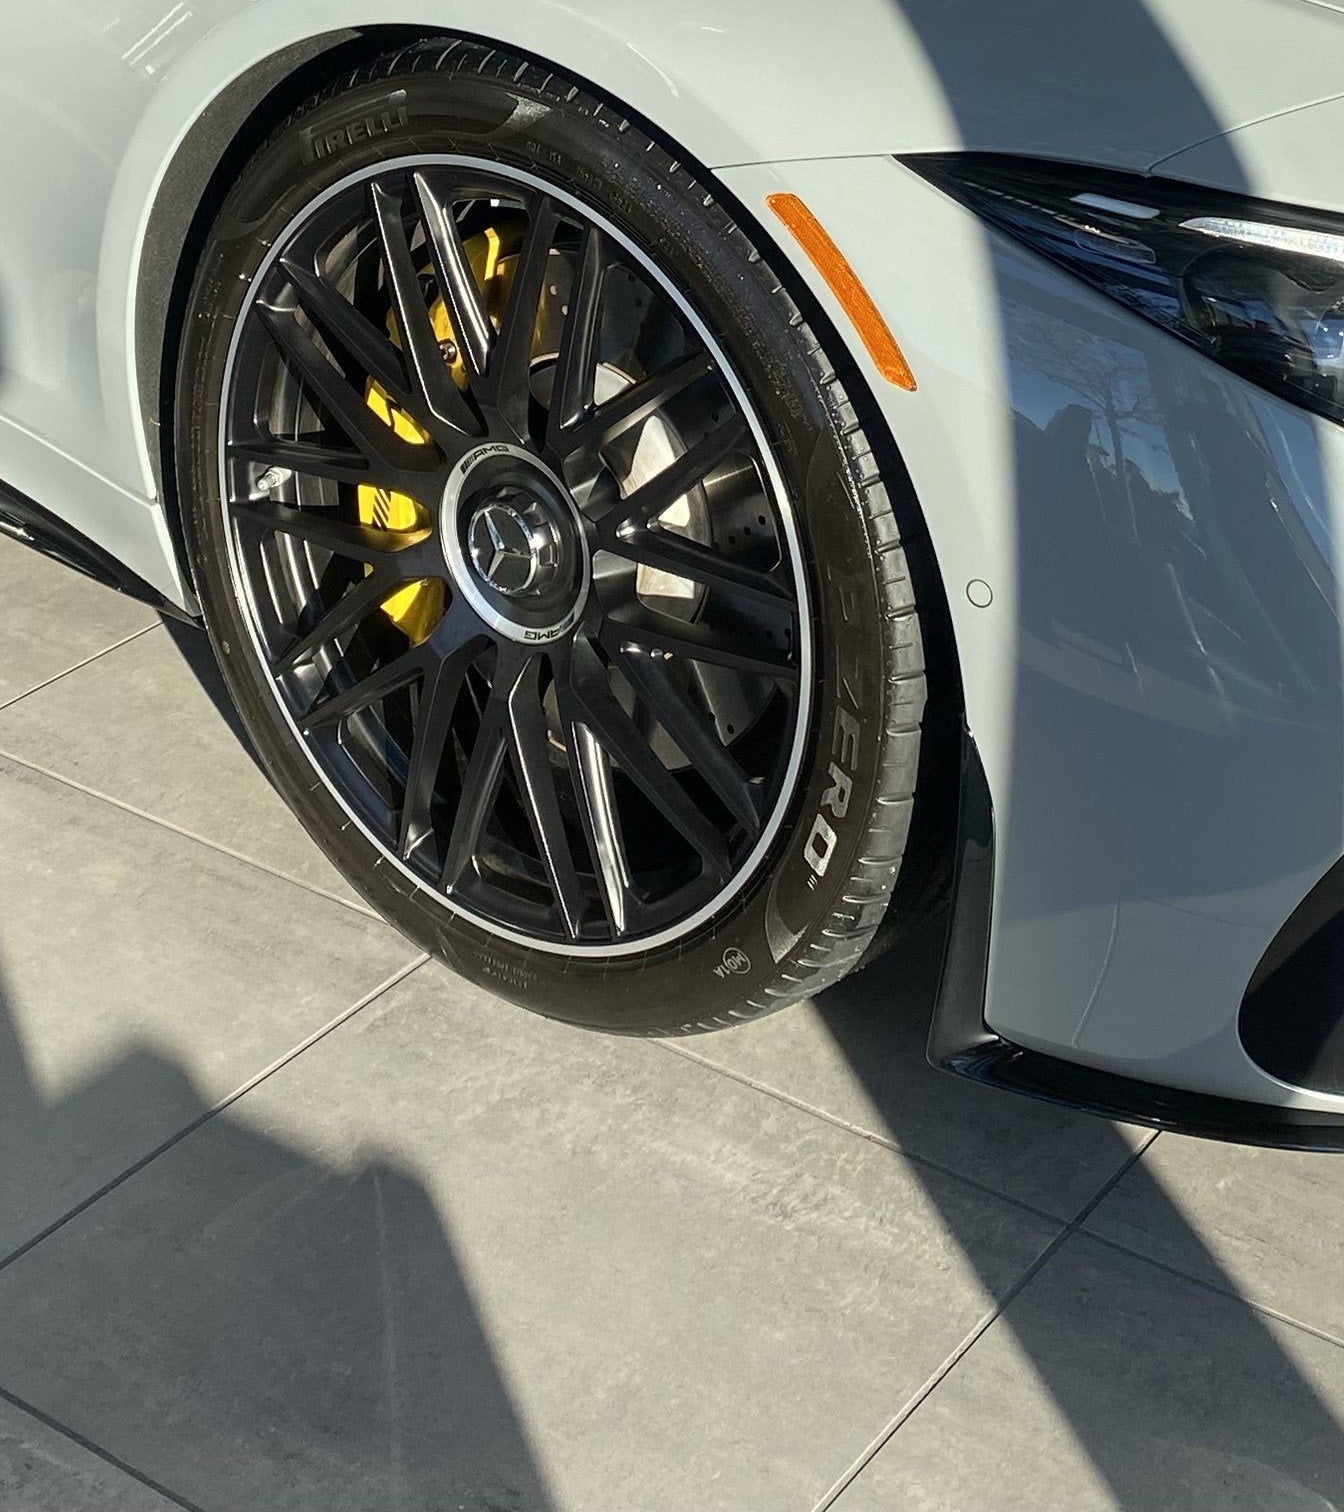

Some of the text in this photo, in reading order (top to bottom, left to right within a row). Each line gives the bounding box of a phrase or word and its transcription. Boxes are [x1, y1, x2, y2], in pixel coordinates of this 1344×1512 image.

[298, 89, 409, 167] PIRELLI
[474, 445, 509, 461] AMG
[524, 626, 560, 641] AMG
